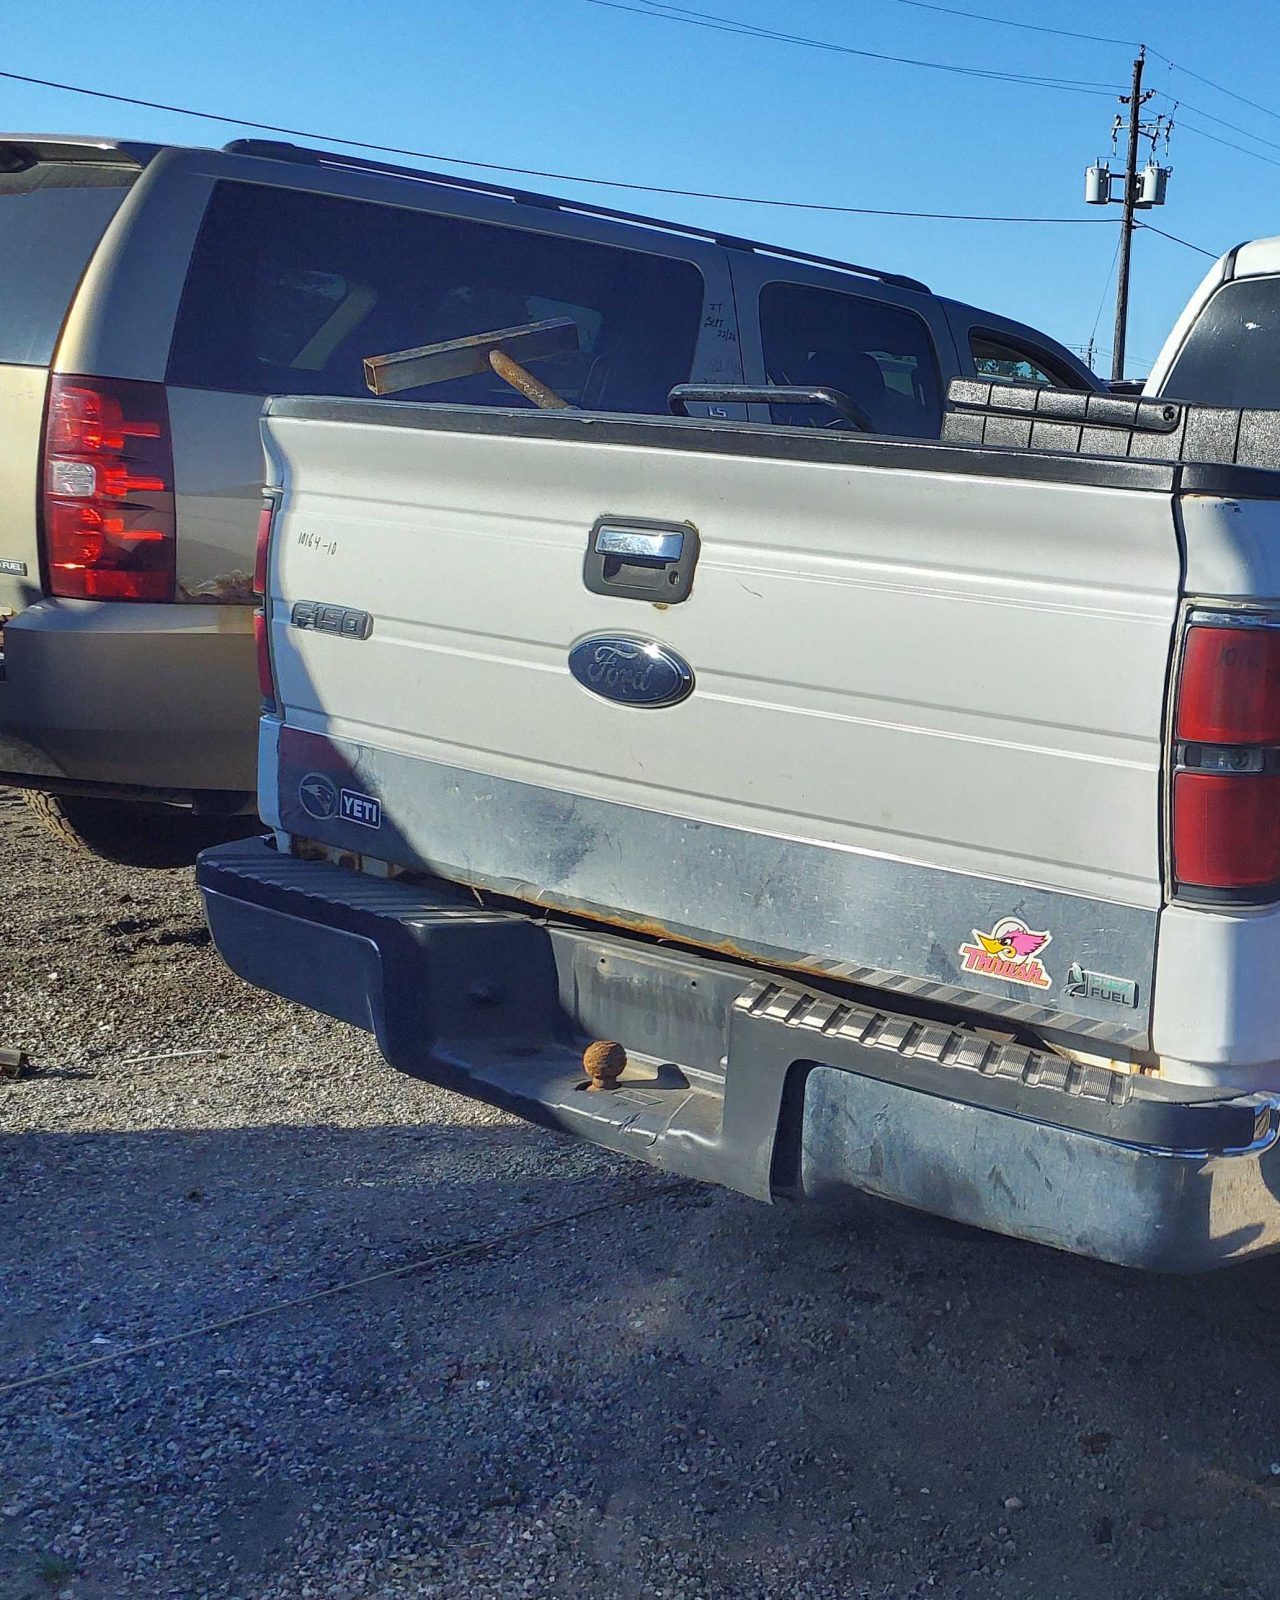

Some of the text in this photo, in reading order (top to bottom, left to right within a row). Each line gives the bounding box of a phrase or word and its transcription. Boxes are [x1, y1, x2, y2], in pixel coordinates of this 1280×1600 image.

[587, 645, 654, 691] Ford
[343, 795, 377, 822] YETI
[1091, 986, 1131, 1005] FUEL
